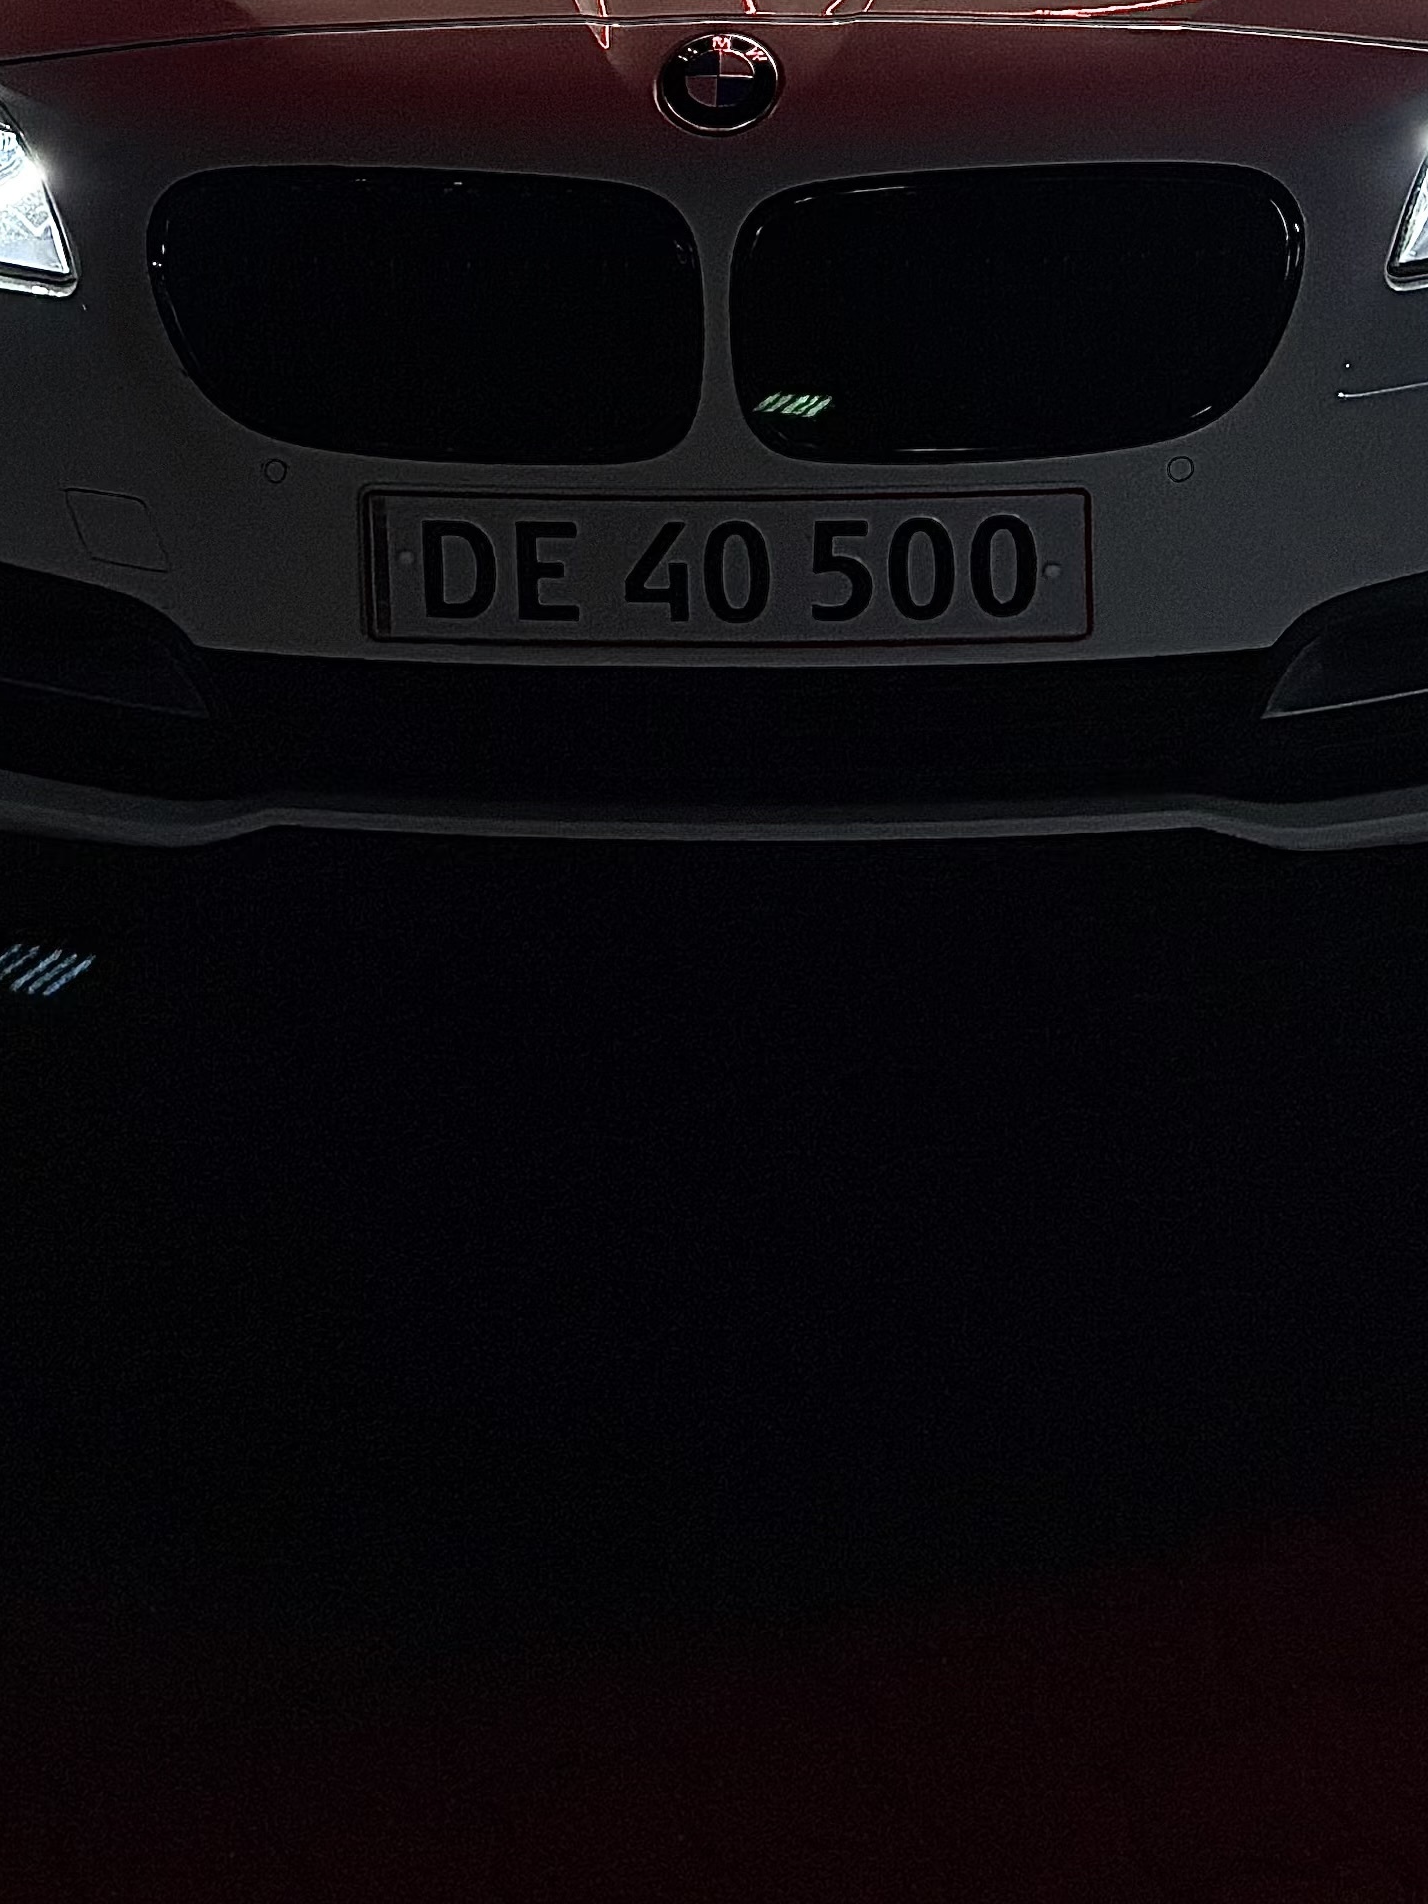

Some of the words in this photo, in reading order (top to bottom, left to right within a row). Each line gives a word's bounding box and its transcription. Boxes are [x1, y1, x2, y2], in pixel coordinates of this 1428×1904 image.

[420, 519, 581, 621] DE
[624, 519, 771, 624] 40
[810, 513, 1038, 622] 500
